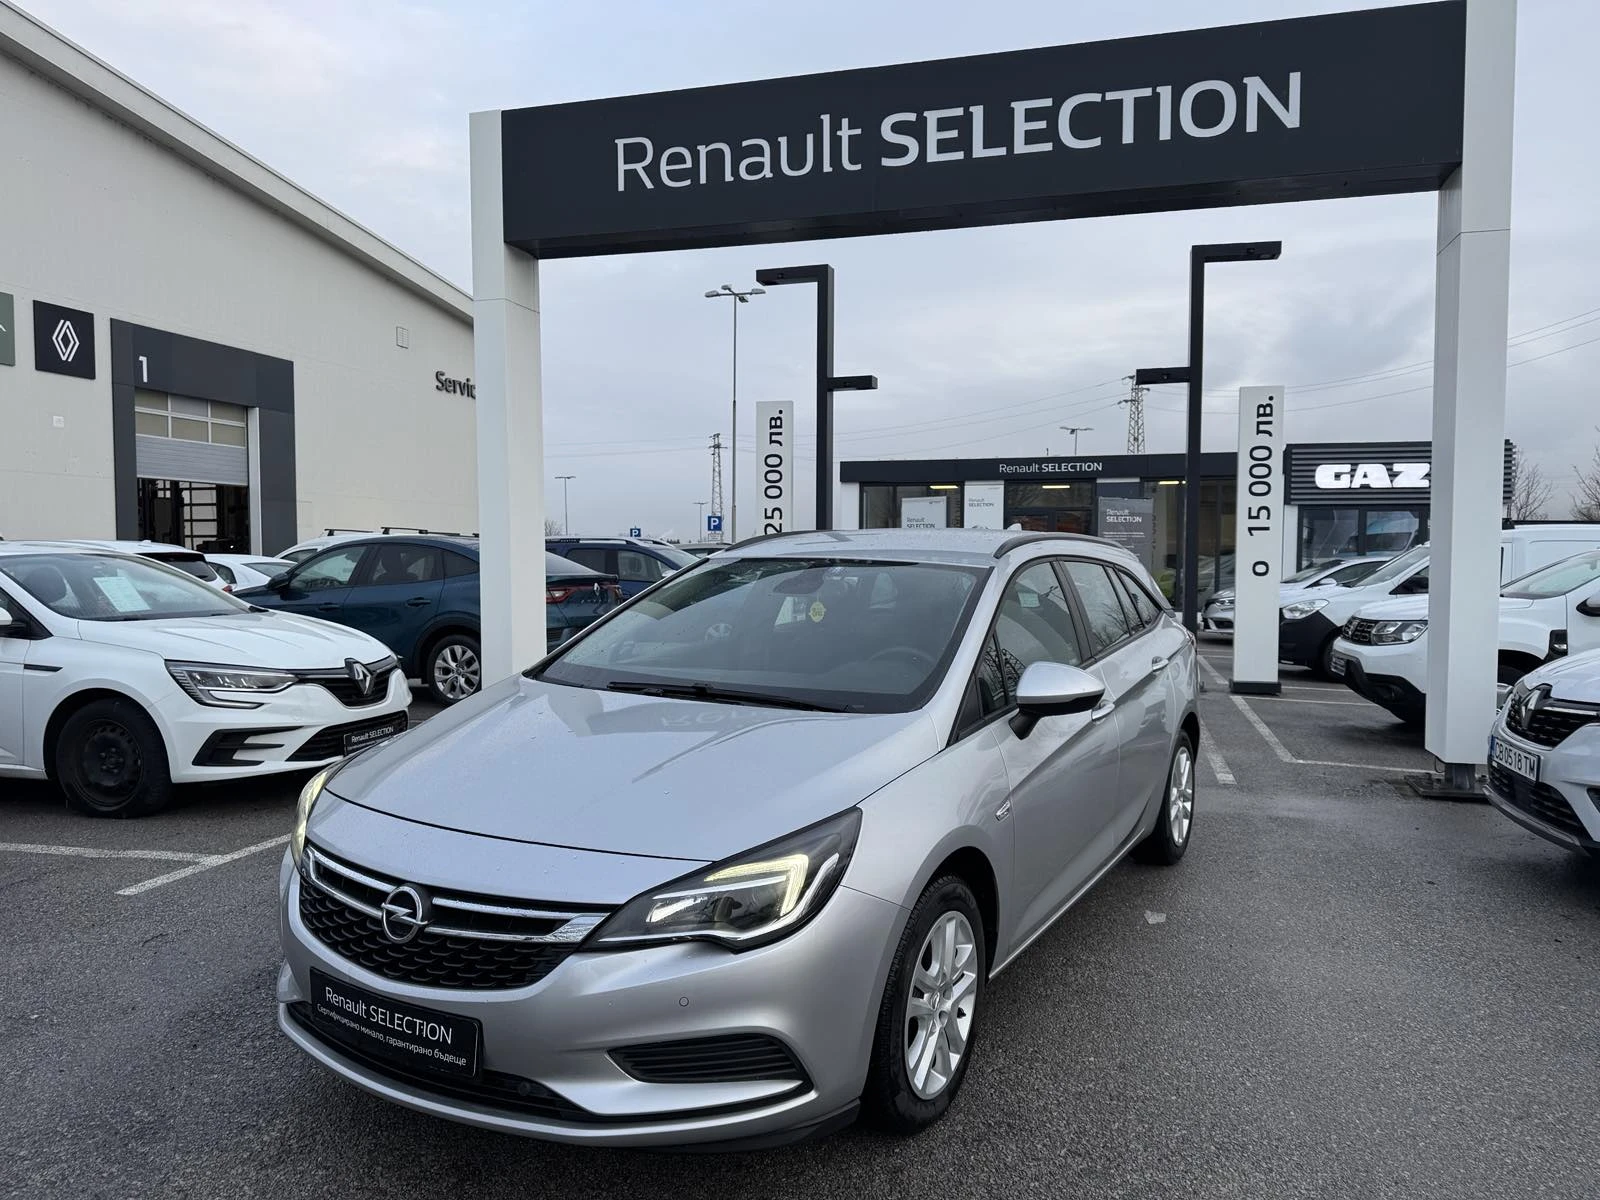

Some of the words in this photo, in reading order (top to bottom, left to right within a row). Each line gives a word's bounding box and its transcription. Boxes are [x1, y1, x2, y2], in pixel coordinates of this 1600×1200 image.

[614, 113, 862, 192] Renault
[880, 71, 1301, 167] SELECTION
[138, 355, 148, 383] 1
[769, 409, 783, 447] лв.
[1256, 395, 1275, 437] лв.
[763, 453, 783, 500] 000
[999, 462, 1040, 474] Renault
[1041, 462, 1103, 473] SELECTION
[1248, 445, 1273, 497] 000
[1315, 463, 1431, 489] GAZ
[710, 517, 720, 530] P
[763, 507, 783, 535] 25
[1106, 515, 1143, 523] SELECTION
[1247, 505, 1271, 537] 15
[351, 733, 369, 743] Renault
[369, 726, 394, 739] SELECTION
[325, 986, 367, 1019] Renault
[369, 1005, 453, 1045] SELECTION
[360, 1025, 386, 1044] минало,
[386, 1035, 433, 1057] гарантирано
[433, 1048, 467, 1067] бъдеще
